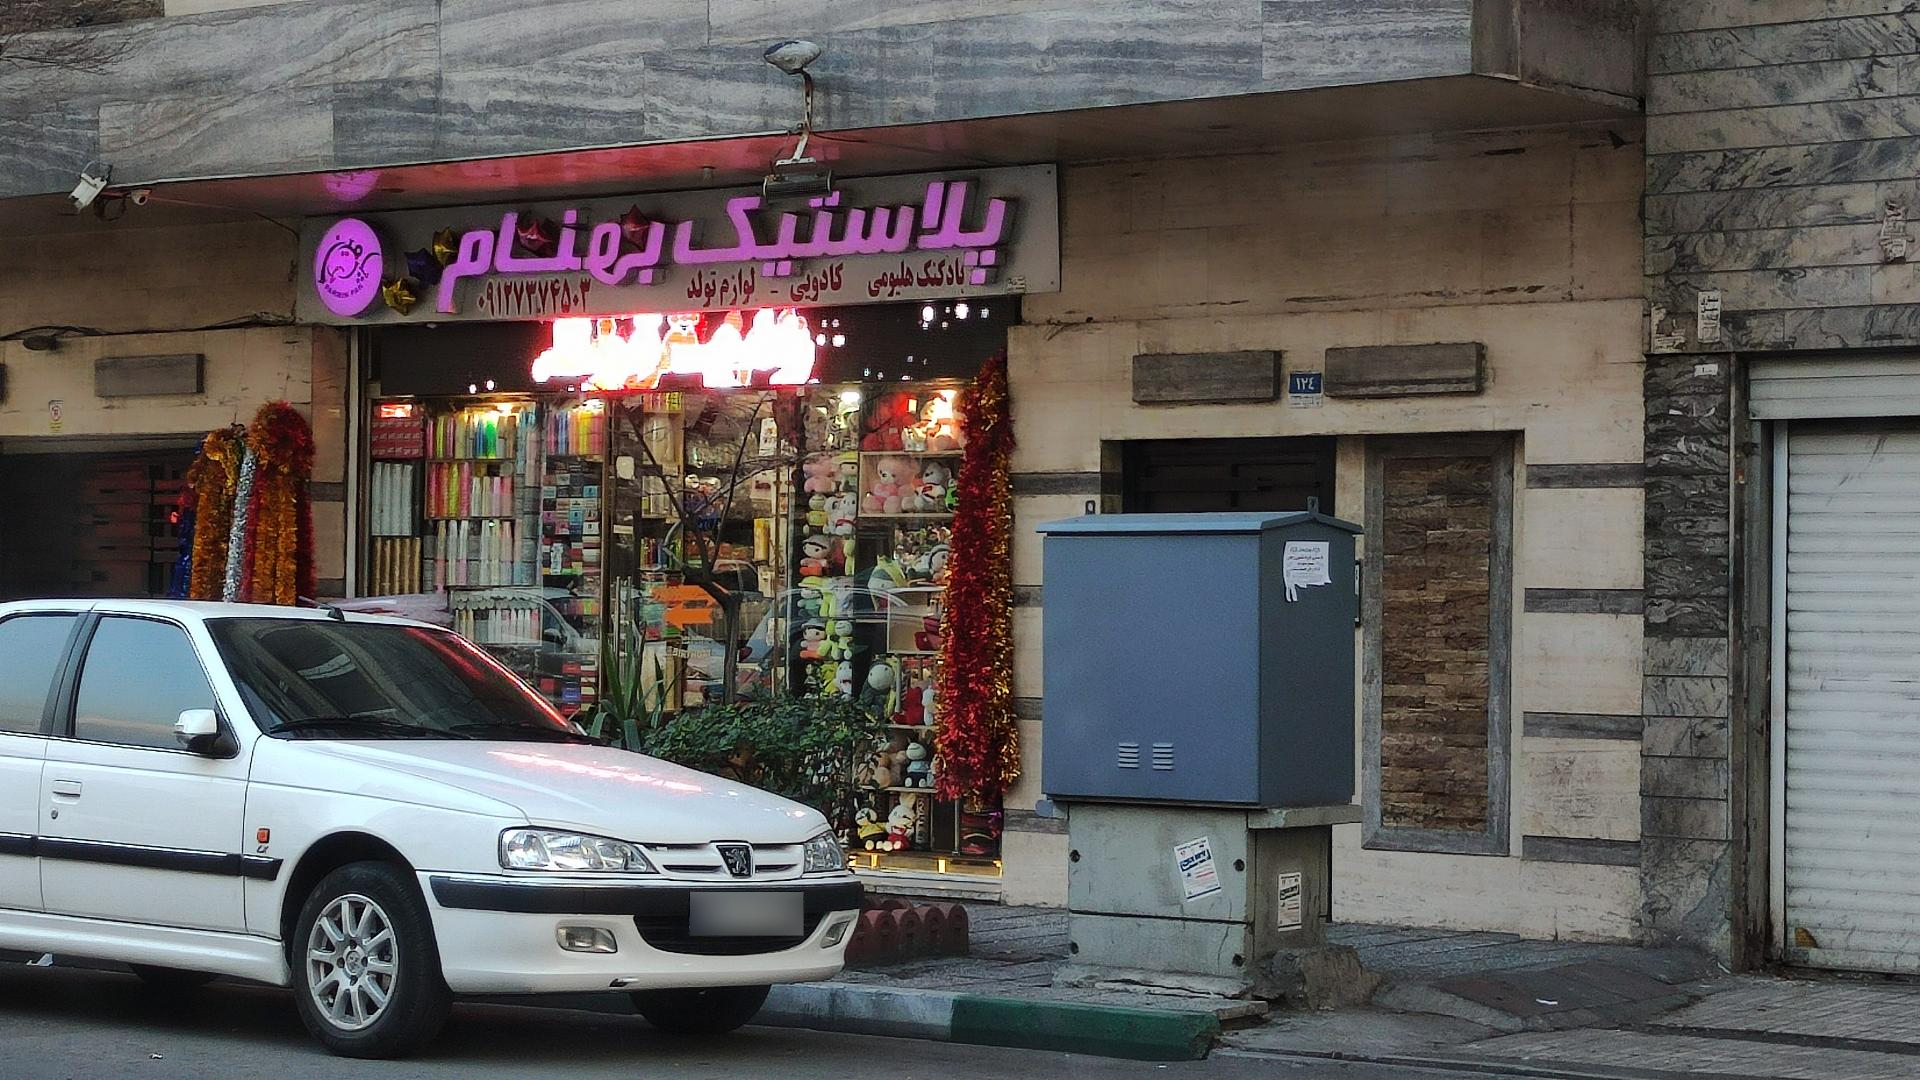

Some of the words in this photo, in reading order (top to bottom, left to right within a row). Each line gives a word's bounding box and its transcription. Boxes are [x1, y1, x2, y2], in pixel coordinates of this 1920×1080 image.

[673, 181, 1006, 285] پلاستیک
[436, 208, 665, 314] بهنام
[868, 259, 913, 297] هلیومی
[916, 257, 965, 294] بادکنک
[687, 270, 717, 308] تولد
[720, 266, 755, 306] لوازم
[790, 262, 843, 302] کادویی
